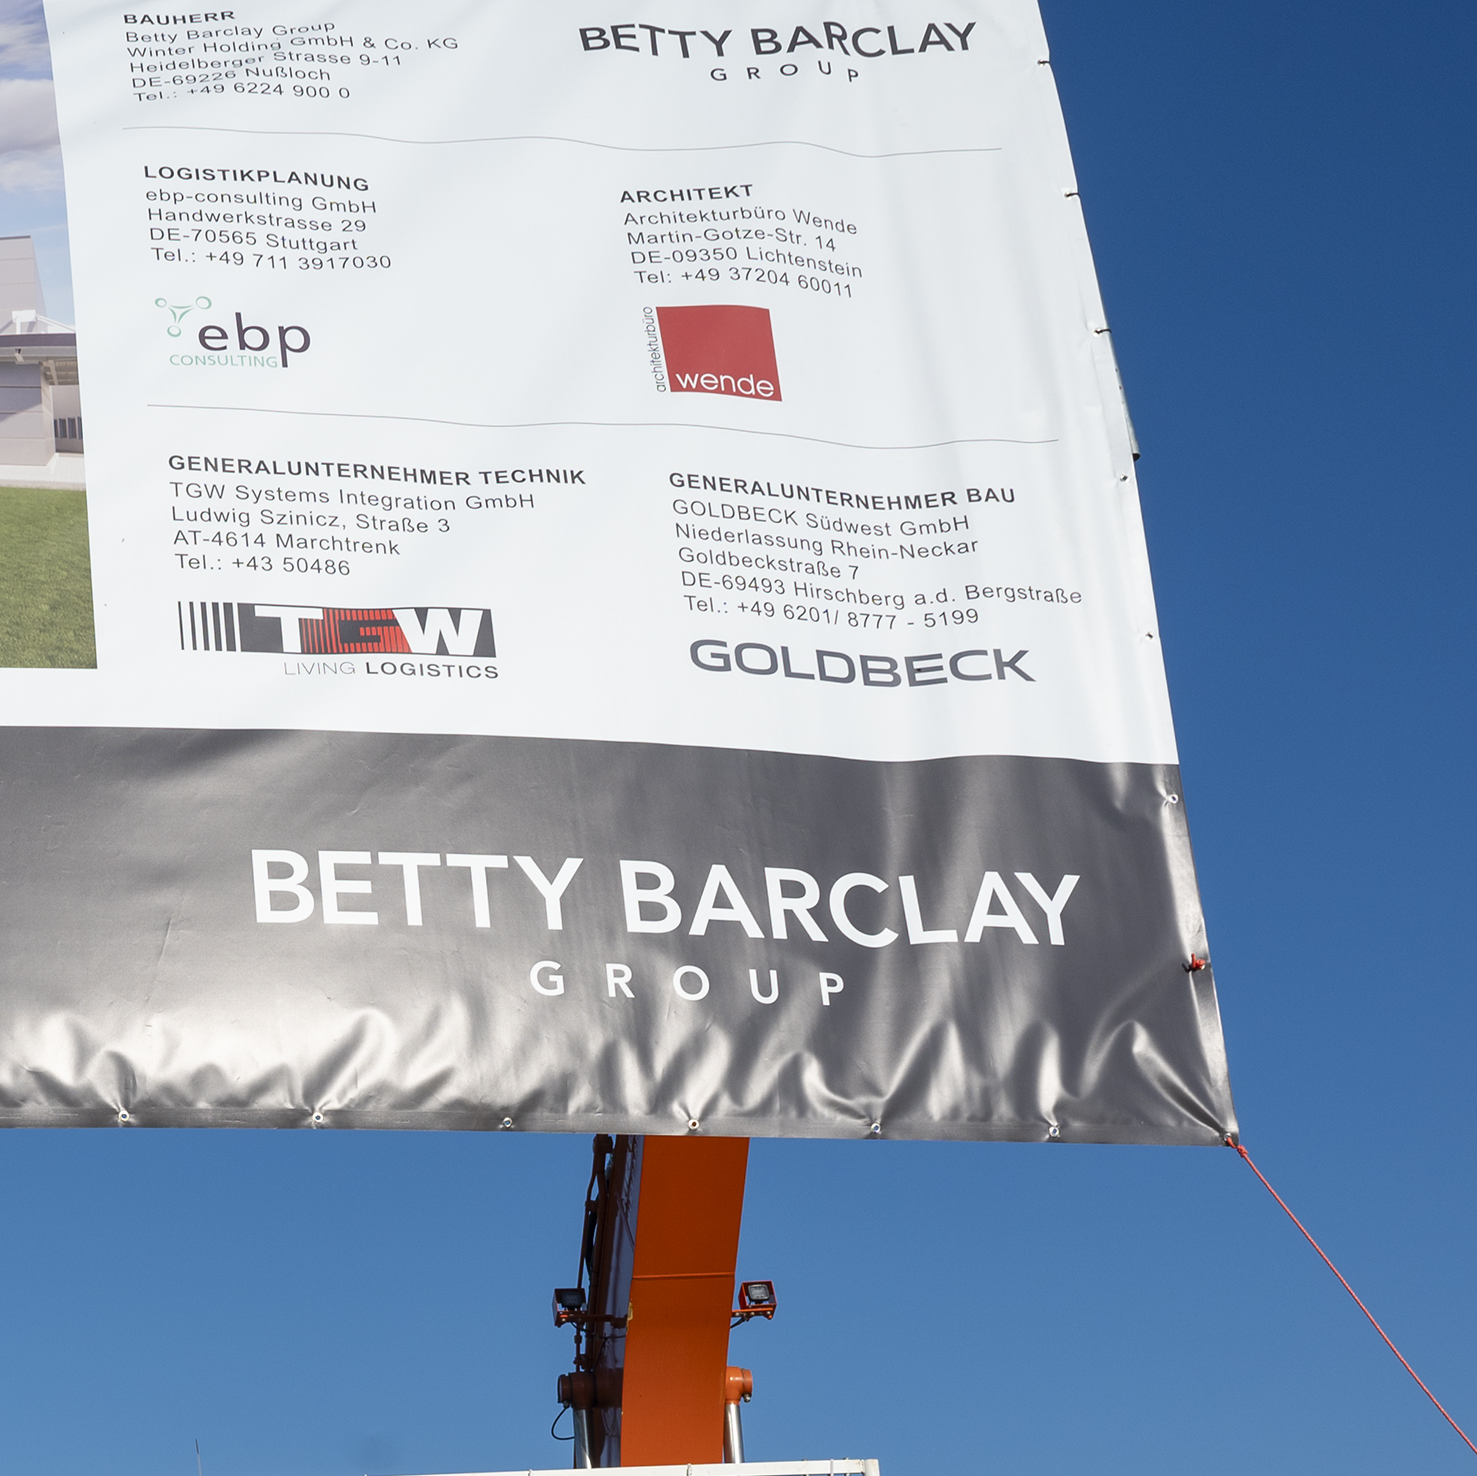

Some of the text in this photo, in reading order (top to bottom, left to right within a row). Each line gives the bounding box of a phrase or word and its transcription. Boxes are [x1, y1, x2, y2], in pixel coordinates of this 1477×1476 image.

[124, 11, 234, 25] BAUHERR
[126, 23, 334, 43] Betty Barclay Group
[579, 22, 976, 58] BETTY BARCLAY
[127, 35, 458, 58] Winter Holding GmbH & Co. KG
[130, 51, 400, 76] Heidelberger Strasse 9-11
[710, 61, 858, 82] GROUP
[132, 67, 330, 90] DE-69226 Nußloch
[133, 83, 349, 102] Tel.: +49 6224 900 0
[144, 166, 368, 191] LOGISTIKPLANUNG
[146, 189, 376, 213] ebp-consulting GmbH
[621, 184, 752, 203] ARCHITEKT
[148, 208, 366, 232] Handwerkstrasse 29
[624, 207, 857, 234] Architekturbüro Wende
[150, 228, 357, 254] DE-70565 Stuttgart
[816, 236, 835, 252] 14
[151, 248, 391, 270] Tel.: +49 711 3917030
[631, 247, 862, 282] DE-09350 Lichtenstein
[634, 267, 851, 297] Tel: +49 37204 60011
[199, 312, 310, 368] ebp
[643, 307, 666, 392] architekturbüro
[170, 355, 277, 368] CONSULTING
[676, 371, 775, 397] wende
[169, 455, 585, 485] GENERALUNTERNEHMER TECHNIK
[170, 482, 534, 511] TGW Systems Integration GmbH
[668, 472, 1014, 511] GENERALUNTERNEHMER BAU
[172, 506, 450, 533] Ludwig Szinicz, Straße 3
[673, 499, 968, 536] GOLDBECK Südwest GmbH
[174, 530, 400, 555] AT-4614 Marchtrenk
[676, 523, 978, 559] Niederlassung Rhein-Neckar
[175, 554, 350, 575] Tel.: +43 50486
[679, 547, 858, 580] Goldbeckstraße 7
[682, 571, 1081, 610] DE-69493 Hirschberg a.d. Bergstraße
[684, 595, 727, 613] Tel.:
[738, 601, 774, 617] +49
[848, 612, 896, 629] 8777
[925, 609, 978, 627] 5199
[254, 604, 484, 656] TGW
[284, 662, 498, 679] LIVING LOGISTICS
[690, 640, 1035, 687] GOLDBECK
[252, 849, 1080, 948] BETTY BARCLAY
[529, 960, 846, 1005] GROUP
